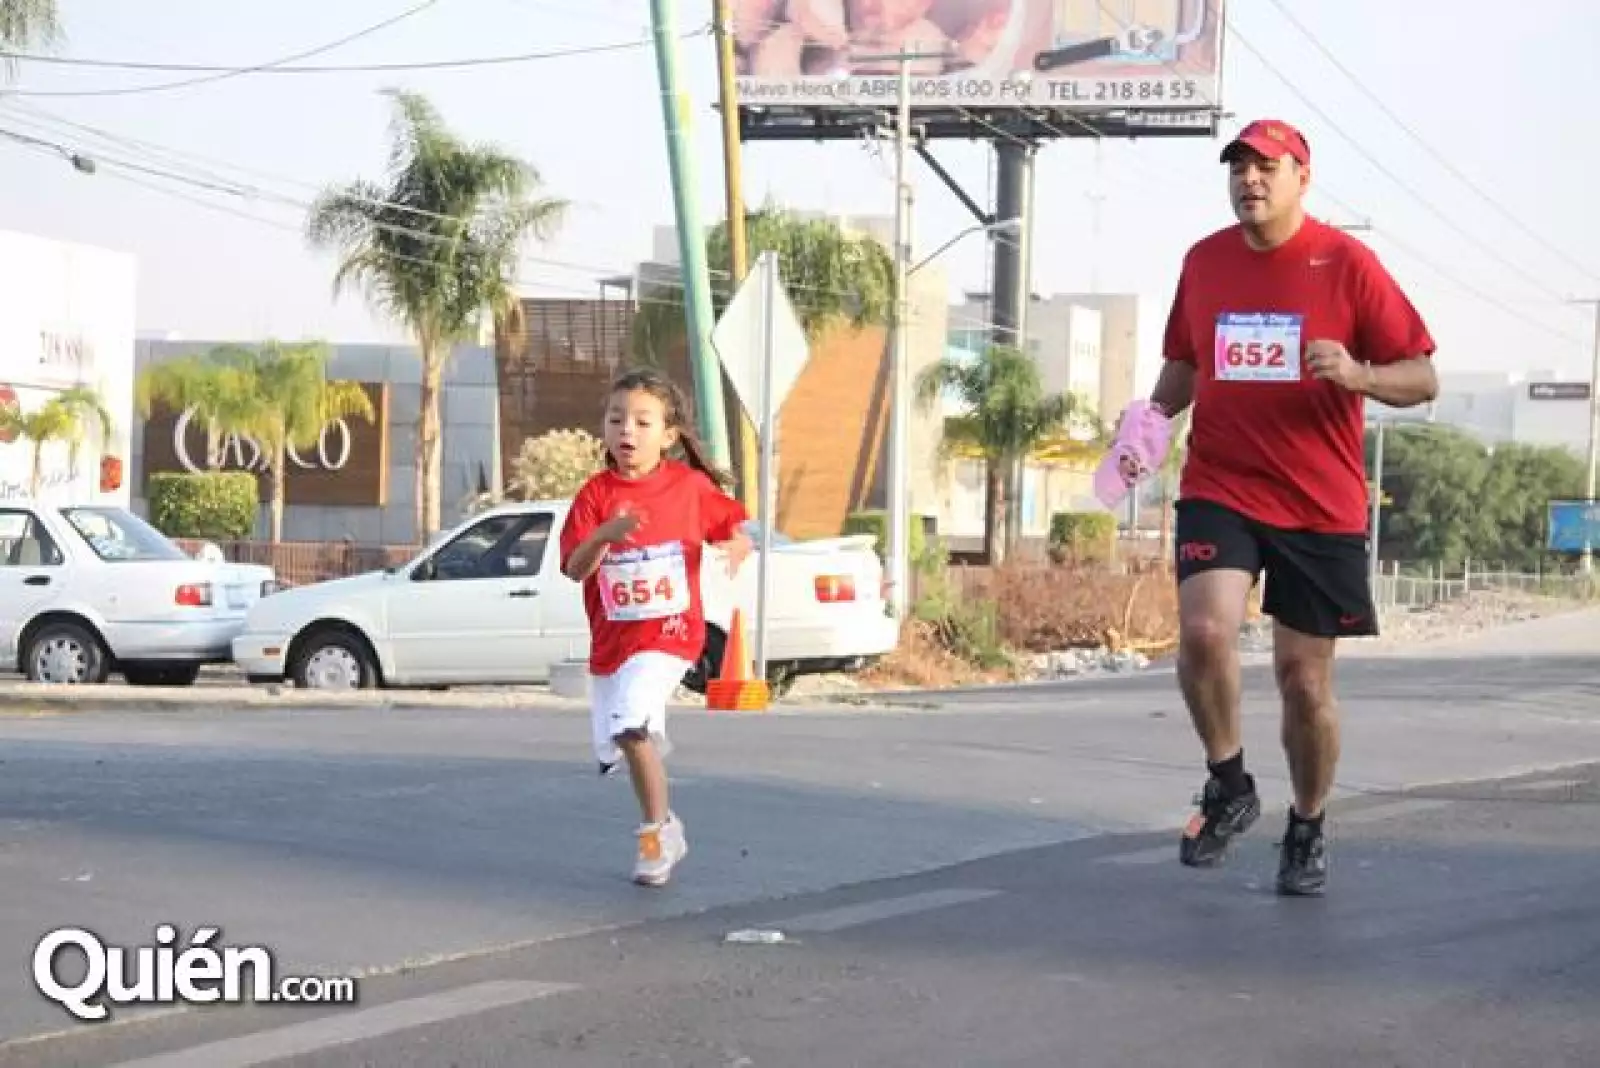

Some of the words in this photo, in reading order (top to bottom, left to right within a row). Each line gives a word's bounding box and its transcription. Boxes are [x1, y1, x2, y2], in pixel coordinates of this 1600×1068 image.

[859, 79, 950, 97] ABRMOS
[1095, 79, 1133, 100] 218
[1139, 79, 1164, 98] 84
[1169, 79, 1196, 99] 55
[1227, 342, 1285, 367] 652
[611, 576, 674, 606] 654
